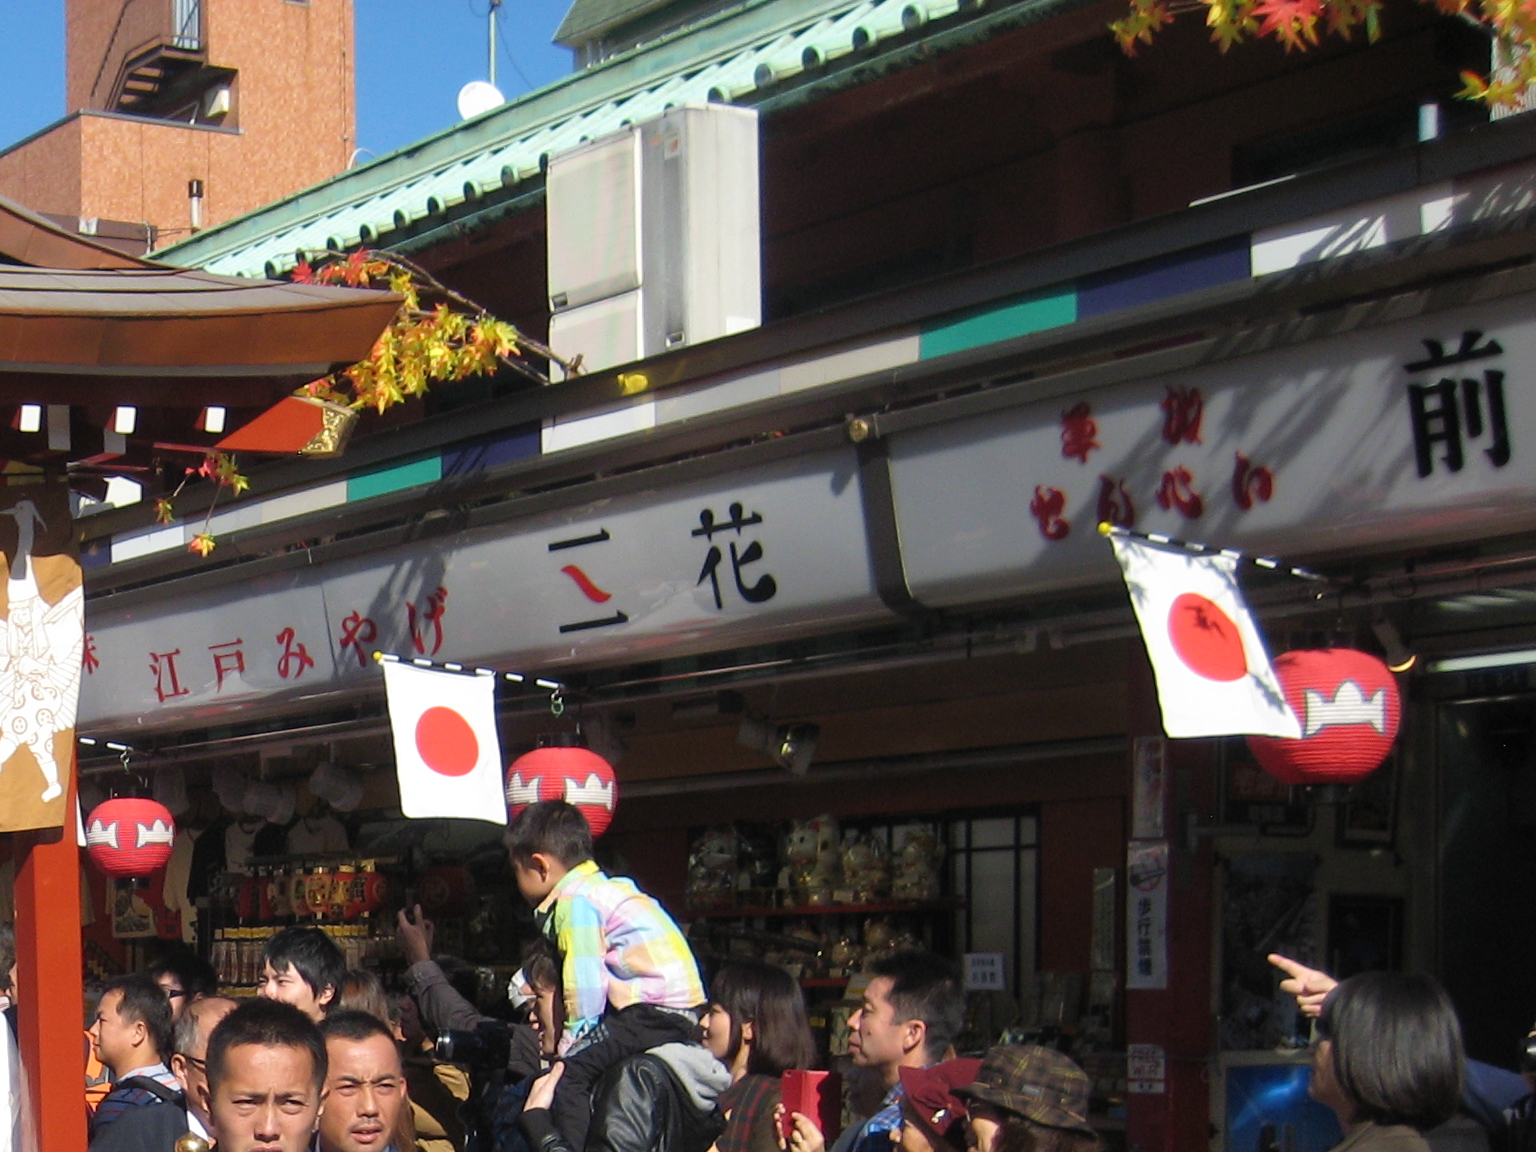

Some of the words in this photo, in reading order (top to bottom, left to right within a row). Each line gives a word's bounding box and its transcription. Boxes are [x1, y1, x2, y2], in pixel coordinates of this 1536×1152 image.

[1403, 330, 1511, 479] 前
[1030, 450, 1274, 541] せんべい
[149, 586, 448, 703] 江戸みやげ
